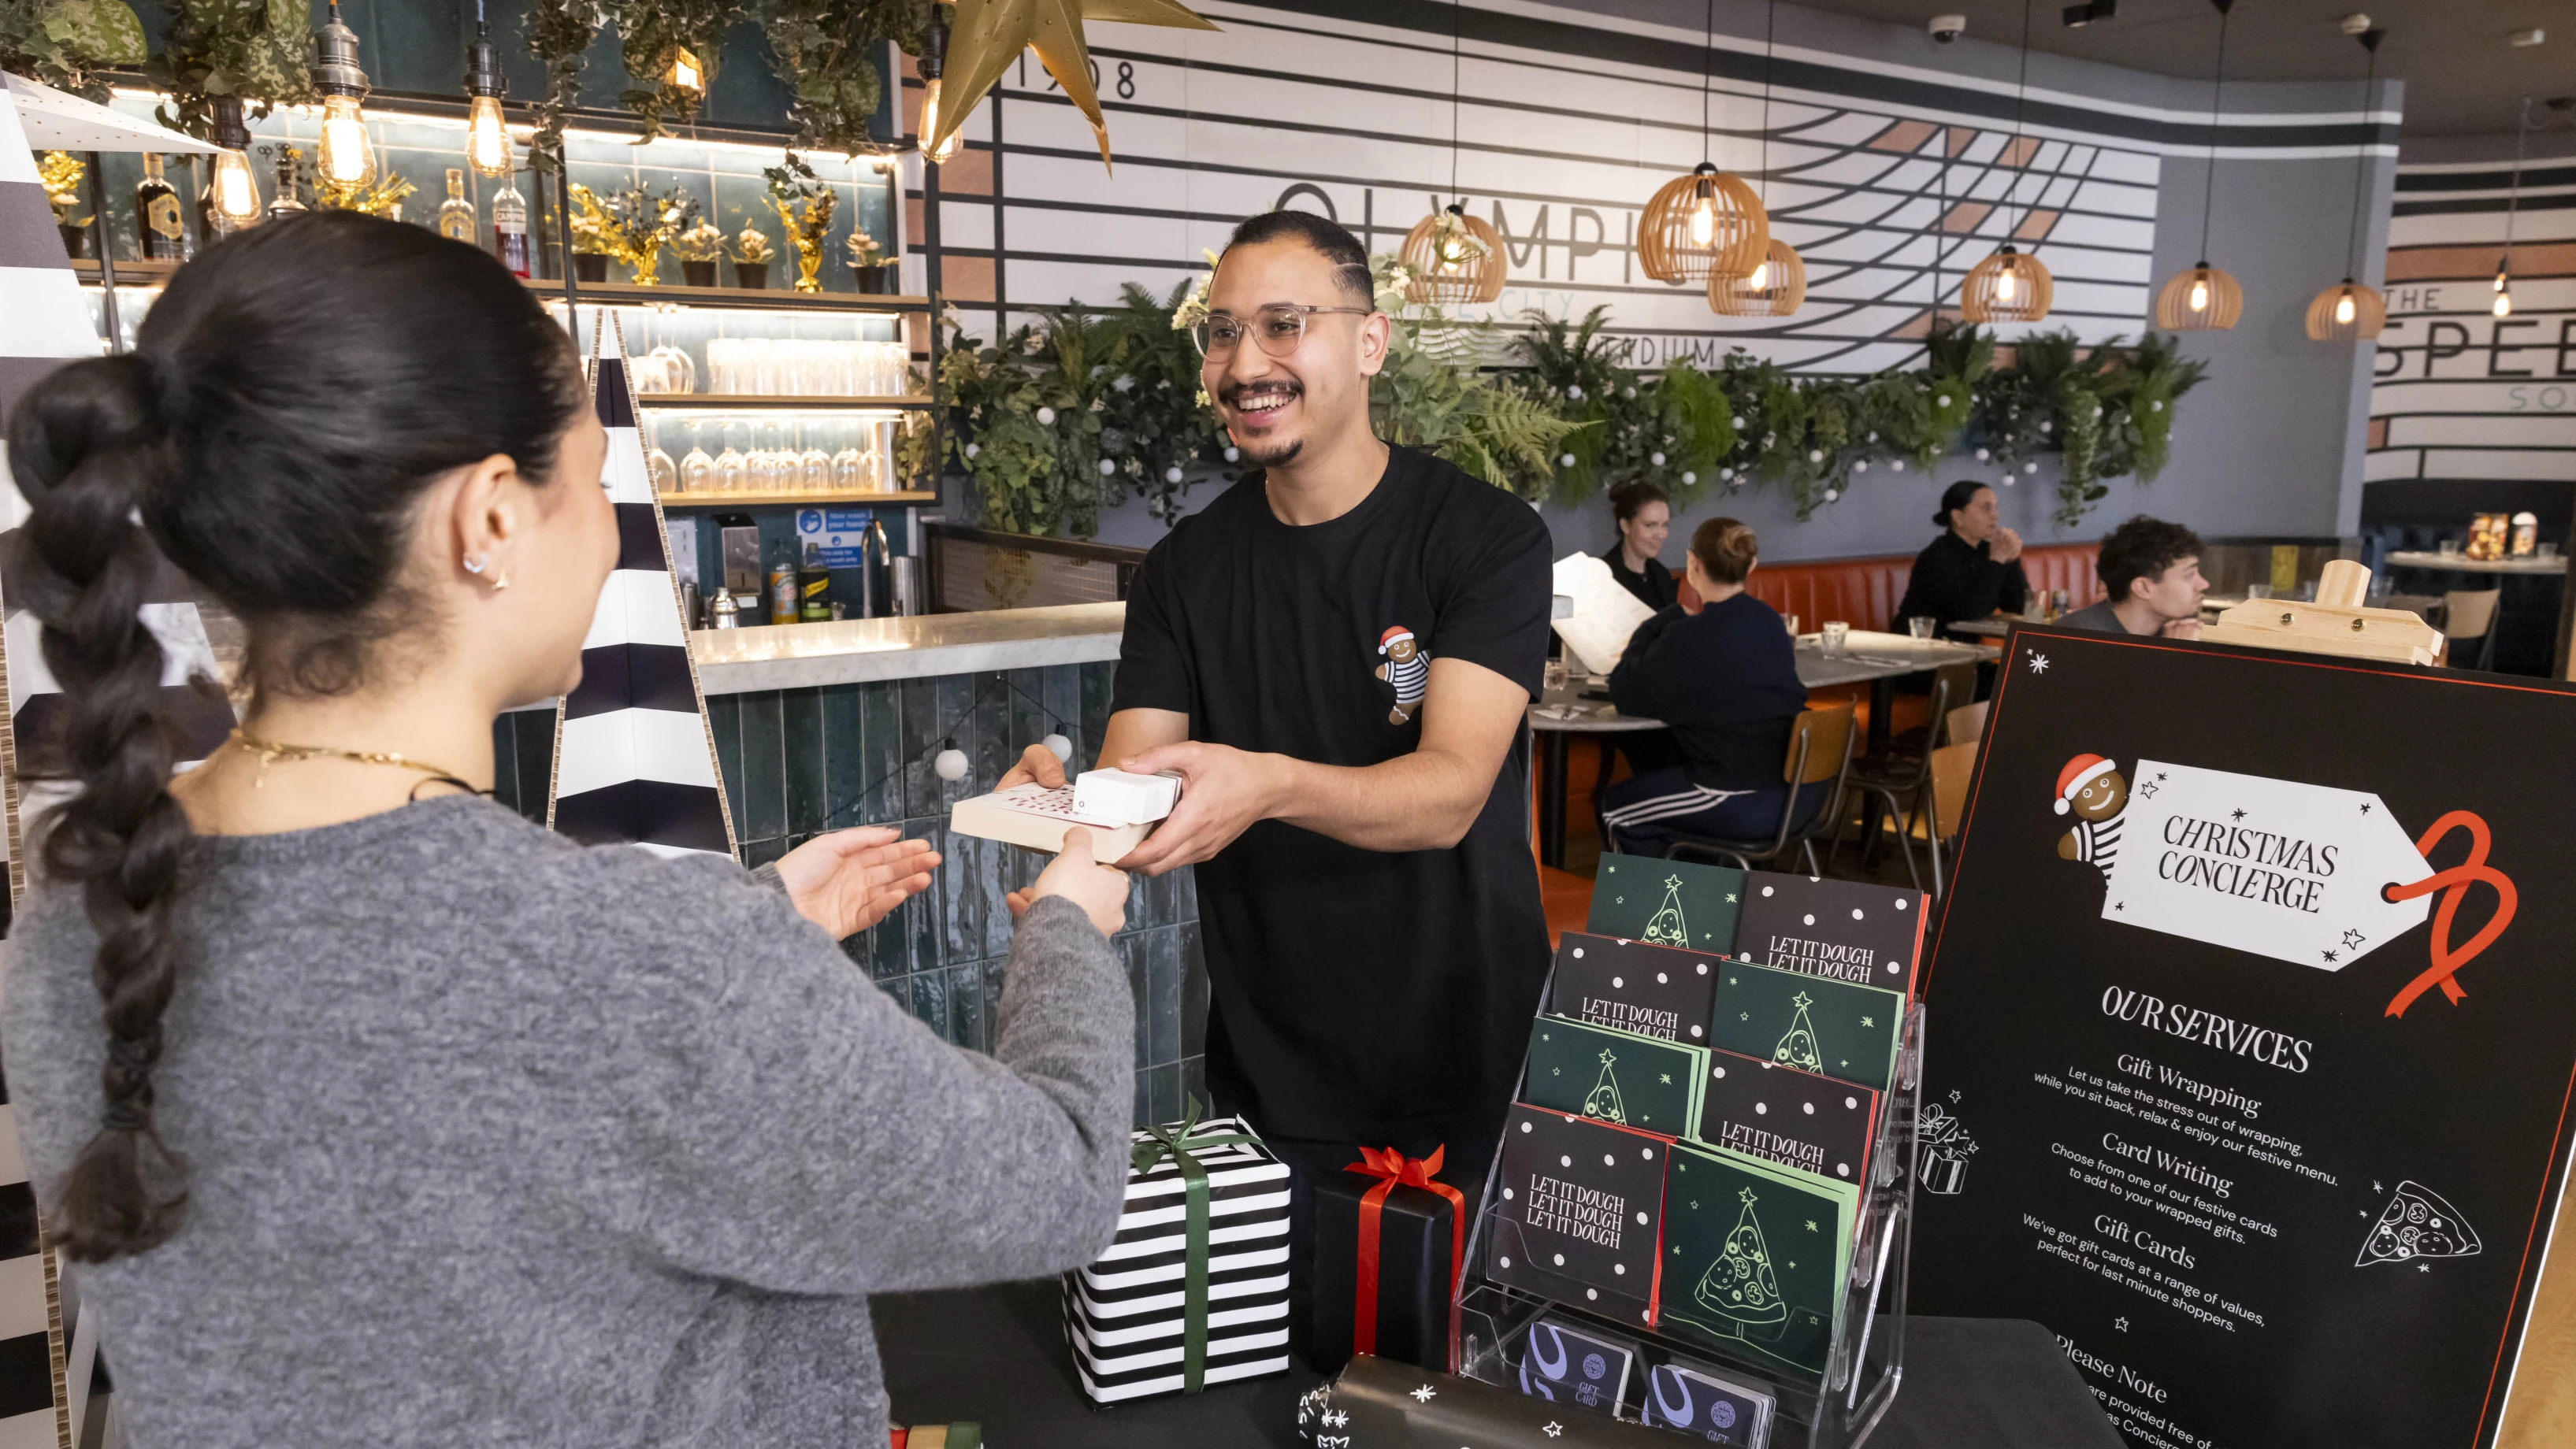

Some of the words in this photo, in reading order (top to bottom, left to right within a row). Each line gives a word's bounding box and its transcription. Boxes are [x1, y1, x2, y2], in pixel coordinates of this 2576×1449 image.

[1275, 183, 1687, 286] LMPI
[2383, 288, 2442, 312] THE
[1600, 336, 1715, 367] TADIUM
[2509, 386, 2576, 411] SO
[2164, 815, 2339, 876] CHRISTMAS
[2158, 850, 2325, 914] CONCIERGE
[1767, 952, 1798, 971] LET
[1800, 957, 1817, 974] IT
[1817, 960, 1872, 984] DOUGH
[1769, 936, 1802, 954] LET
[1802, 940, 1819, 958] IT
[1820, 943, 1874, 966] DOUGH
[1582, 997, 1611, 1017] LET
[1613, 1002, 1628, 1019] IT
[1628, 1006, 1678, 1029] DOUGH
[2102, 985, 2165, 1031] OUR
[2165, 1004, 2313, 1073] SERVICES
[2068, 1065, 2088, 1082] Let
[2089, 1076, 2103, 1087] us
[2106, 1080, 2131, 1096] take
[2134, 1089, 2154, 1104] the
[2156, 1099, 2194, 1118] stress
[2196, 1112, 2220, 1127] out
[2222, 1120, 2237, 1132] of
[2239, 1125, 2303, 1157] wrapping,
[2117, 1054, 2154, 1080] Gift
[2159, 1065, 2262, 1119] Wrapping
[1721, 1121, 1753, 1143] LET
[1754, 1129, 1770, 1148] IT
[1772, 1134, 1824, 1165] DOUGH
[2035, 1073, 2062, 1089] while
[2064, 1084, 2086, 1098] you
[2088, 1091, 2103, 1104] sit
[2104, 1095, 2136, 1117] back,
[2138, 1110, 2169, 1127] relax
[2170, 1118, 2181, 1132] &
[2184, 1125, 2220, 1146] enjoy
[2222, 1139, 2245, 1152] our
[2247, 1144, 2292, 1169] festive
[2295, 1163, 2338, 1187] menu.
[2103, 1132, 2152, 1165] Card
[2157, 1150, 2234, 1199] Writing
[1528, 1191, 1557, 1212] LET
[1558, 1199, 1573, 1217] IT
[1575, 1203, 1623, 1232] DOUGH
[1531, 1173, 1560, 1195] LET
[1561, 1181, 1576, 1199] IT
[1576, 1185, 1624, 1214] DOUGH
[2051, 1143, 2095, 1167] Choose
[2097, 1159, 2125, 1180] from
[2127, 1173, 2151, 1189] one
[2153, 1184, 2168, 1195] of
[2169, 1190, 2192, 1203] our
[2193, 1195, 2236, 1221] festive
[2239, 1216, 2277, 1238] cards
[2069, 1167, 2081, 1179] to
[2084, 1174, 2108, 1190] add
[2110, 1182, 2122, 1195] to
[2125, 1190, 2154, 1206] your
[2155, 1201, 2213, 1231] wrapped
[2213, 1225, 2246, 1244] gifts.
[1527, 1207, 1555, 1229] LET
[1557, 1215, 1572, 1234] IT
[1572, 1220, 1621, 1250] DOUGH
[2094, 1214, 2131, 1243] Gift
[2134, 1231, 2196, 1269] Cards
[2037, 1240, 2080, 1265] perfect
[2082, 1256, 2100, 1272] for
[2101, 1264, 2124, 1284] last
[2125, 1277, 2170, 1303] minute
[2171, 1297, 2236, 1332] shoppers.
[2057, 1231, 2078, 1246] got
[2078, 1240, 2099, 1255] gift
[2101, 1250, 2136, 1270] cards
[2138, 1265, 2151, 1277] at
[2153, 1272, 2162, 1282] a
[2164, 1276, 2201, 1298] range
[2203, 1293, 2219, 1305] of
[2221, 1299, 2265, 1328] values,
[1576, 1392, 1598, 1407] CARD
[1579, 1381, 1600, 1397] GIFT
[2118, 1365, 2167, 1403] Note
[2108, 1395, 2166, 1430] provided
[2168, 1422, 2194, 1443] free
[2196, 1440, 2212, 1449] of
[2123, 1419, 2180, 1449] Concier
